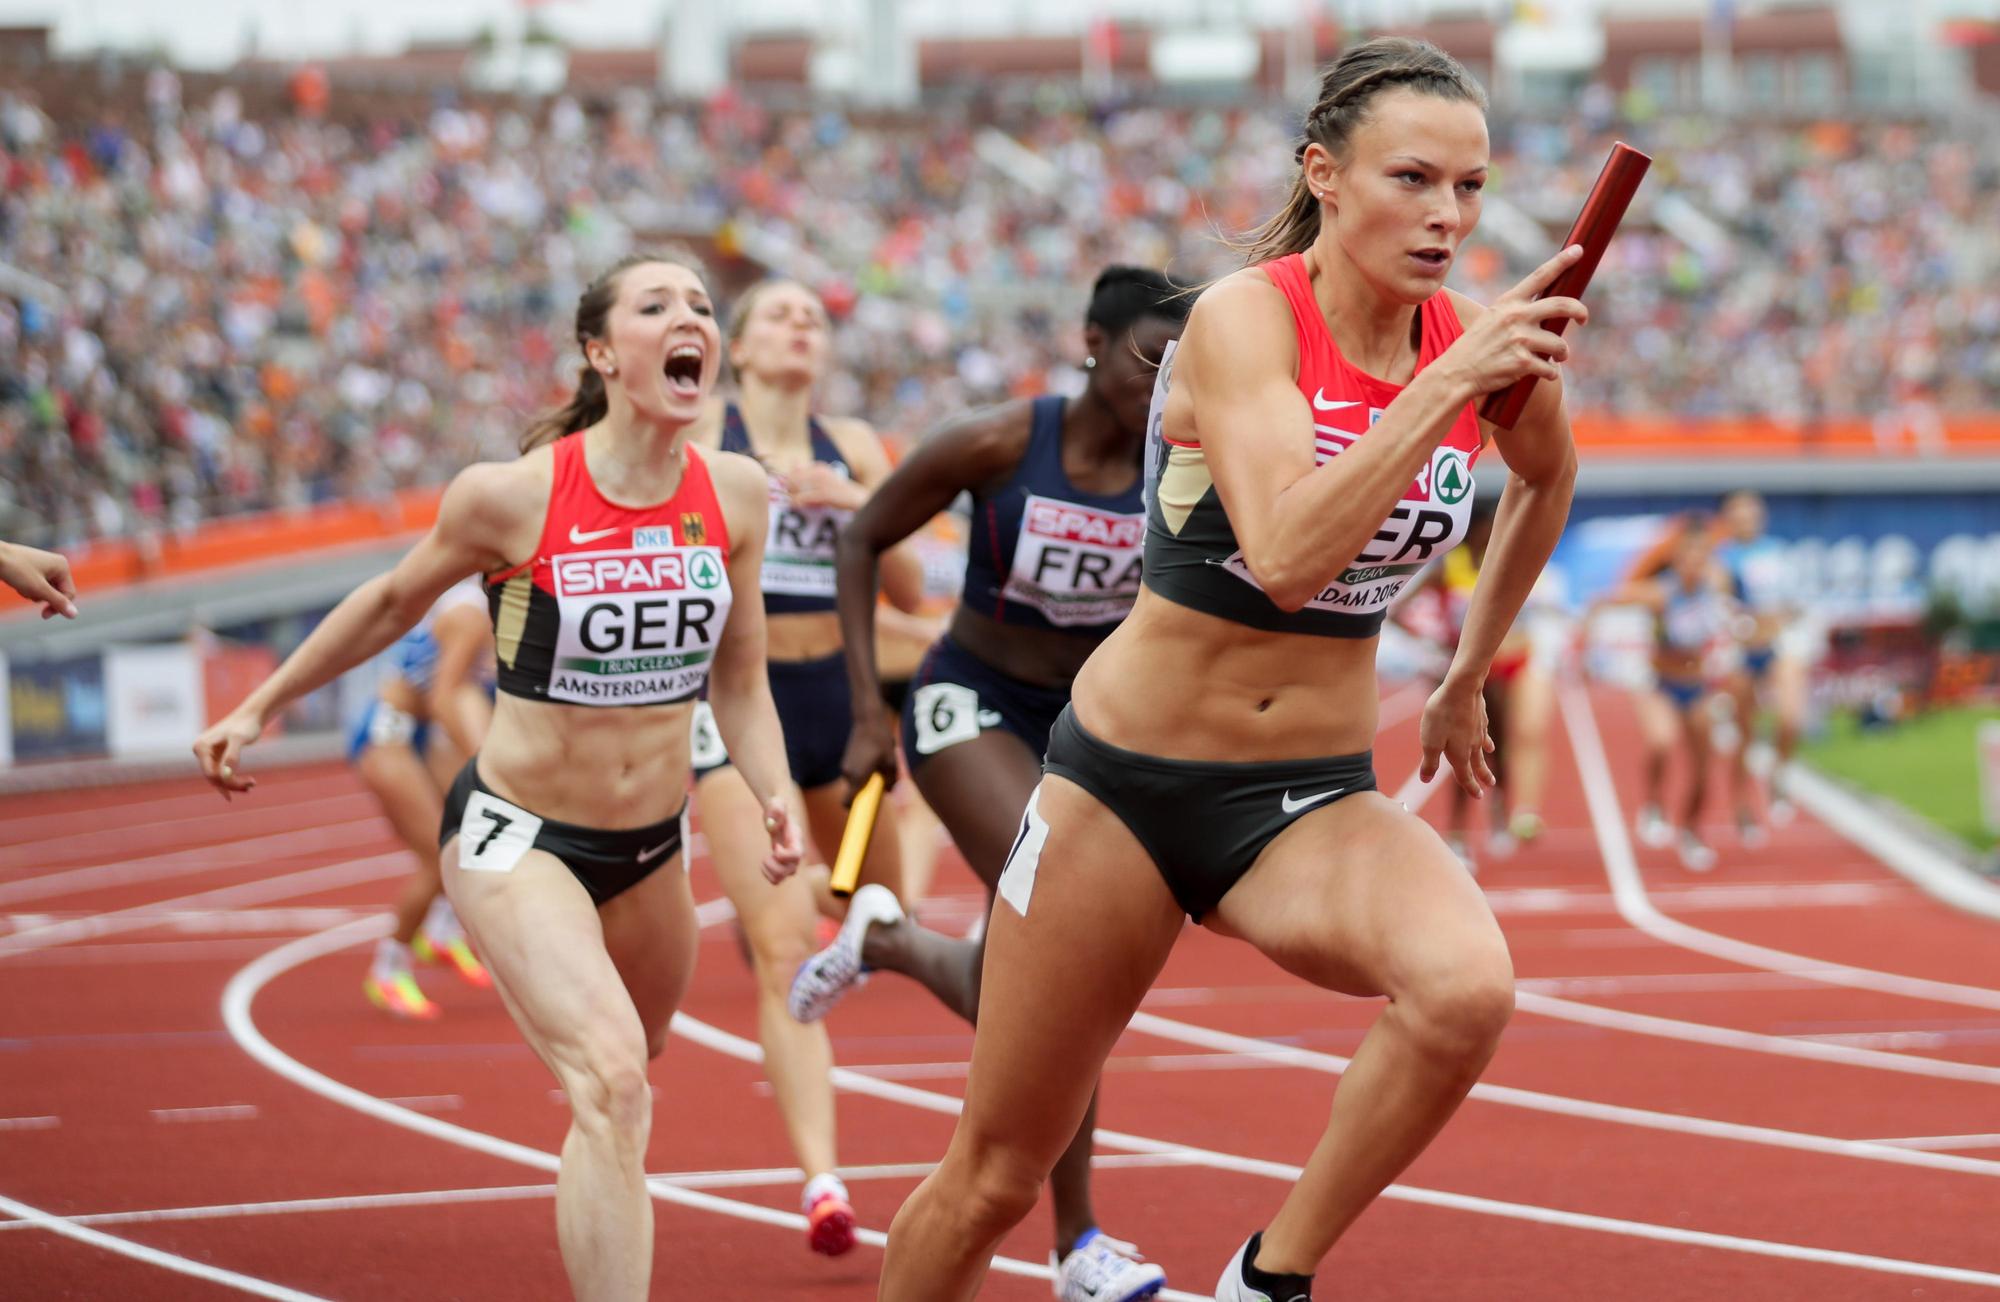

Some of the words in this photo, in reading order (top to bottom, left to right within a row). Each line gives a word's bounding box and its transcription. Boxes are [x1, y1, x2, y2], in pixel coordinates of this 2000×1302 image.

[635, 530, 669, 547] DKB
[775, 510, 838, 548] RA
[1031, 506, 1138, 545] SPAR
[1354, 508, 1453, 563] ER
[561, 556, 683, 593] SPAR
[1034, 546, 1143, 589] FRA
[1345, 566, 1389, 583] CLEAN
[1372, 581, 1403, 604] 2016
[579, 598, 715, 654] GER
[607, 658, 638, 673] RUN
[639, 655, 684, 670] CLEAN
[555, 676, 674, 697] AMSTERDAM
[932, 697, 953, 732] 6
[482, 808, 513, 856] 7
